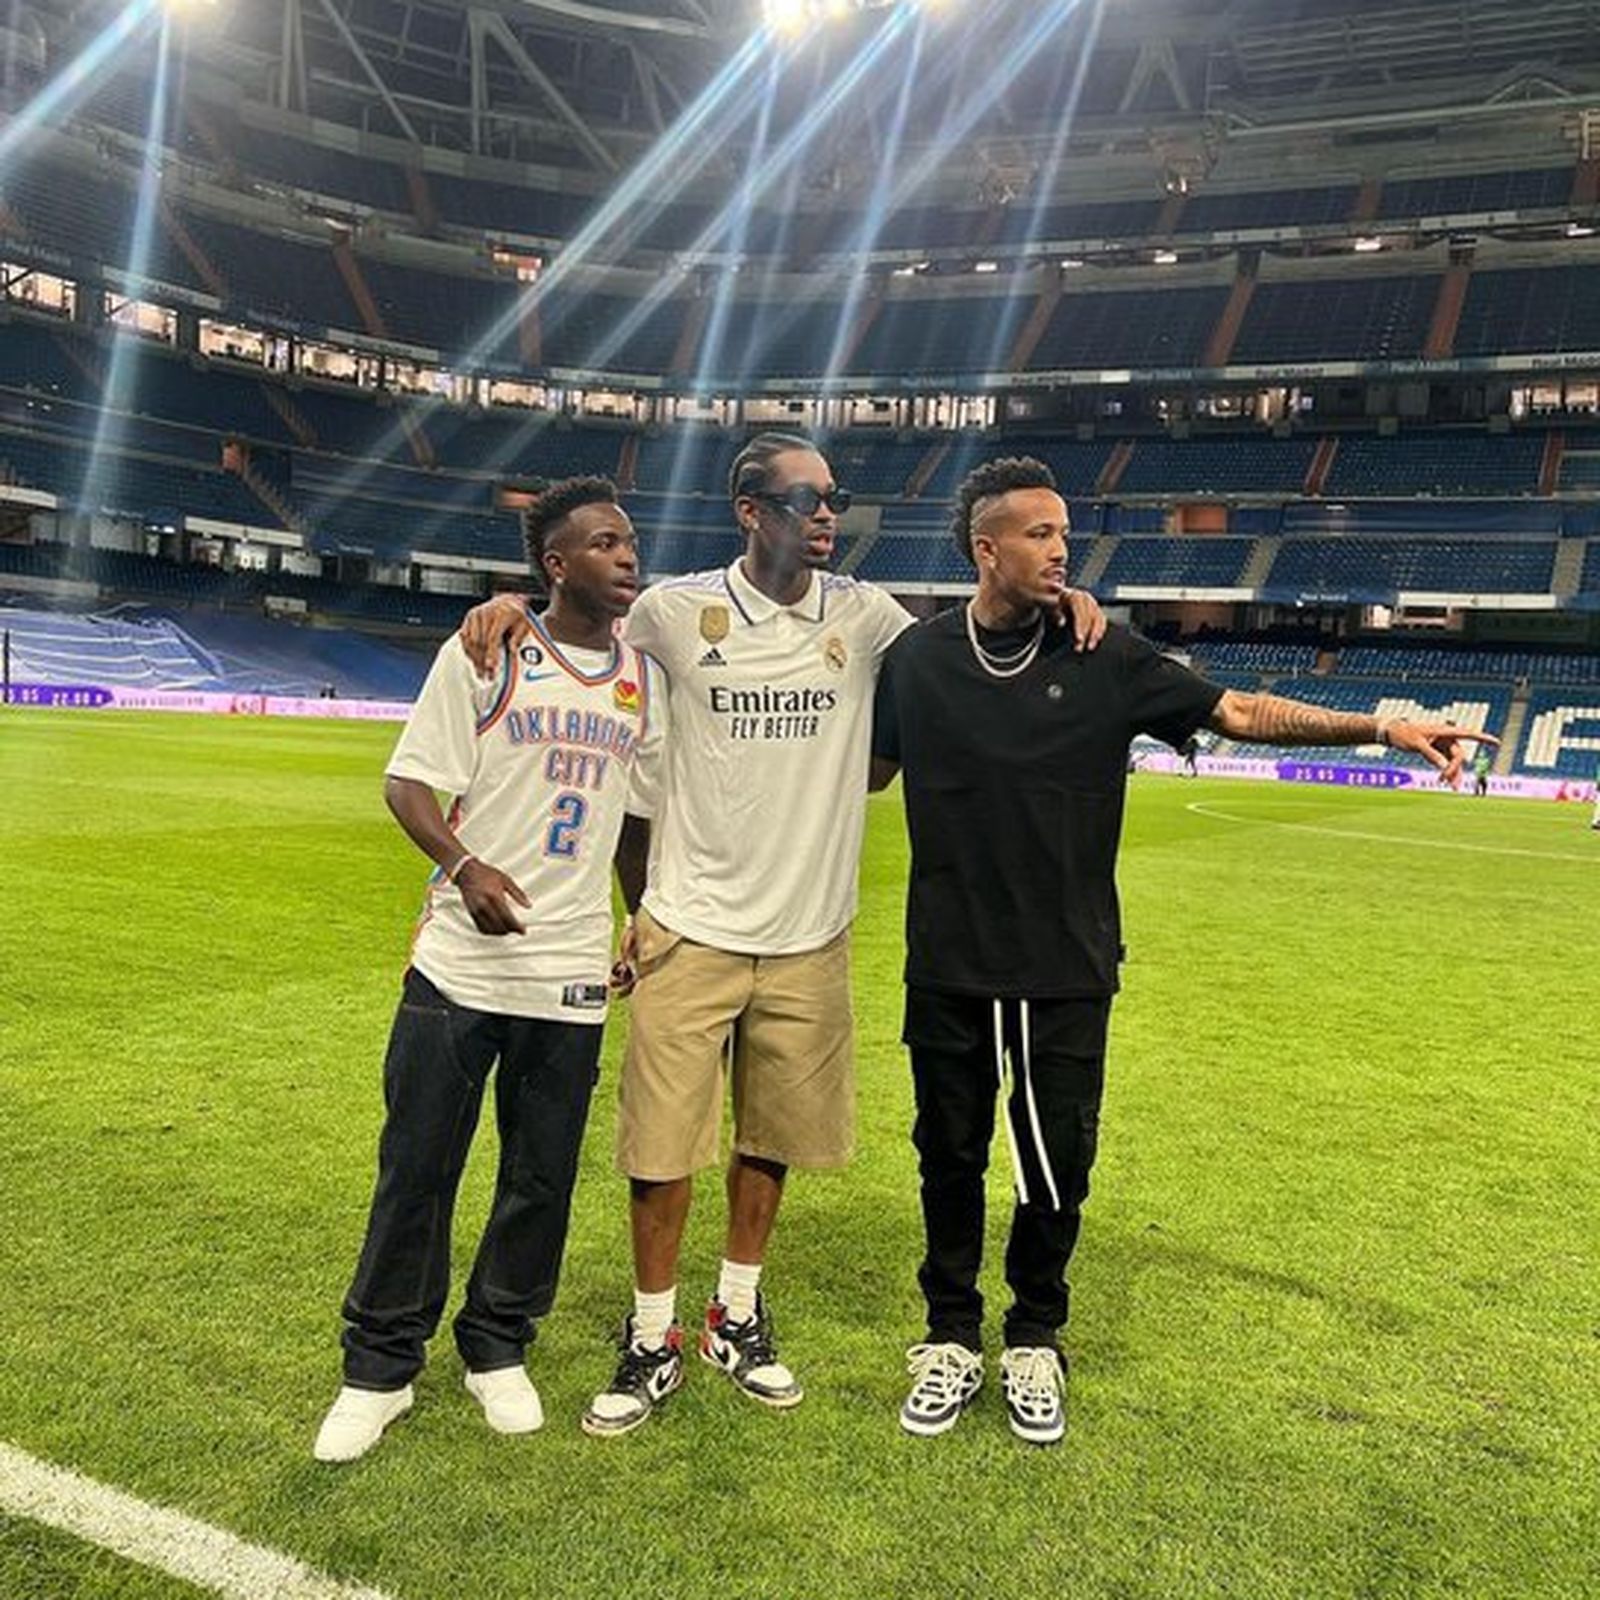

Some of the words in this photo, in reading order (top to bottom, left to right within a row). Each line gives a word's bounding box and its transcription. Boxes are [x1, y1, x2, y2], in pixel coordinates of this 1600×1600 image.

[710, 686, 836, 713] Emirates
[505, 705, 637, 763] OKLAHOM
[731, 717, 757, 740] FLY
[761, 715, 819, 739] BETTER
[545, 747, 607, 791] CITY
[543, 790, 589, 862] 2
